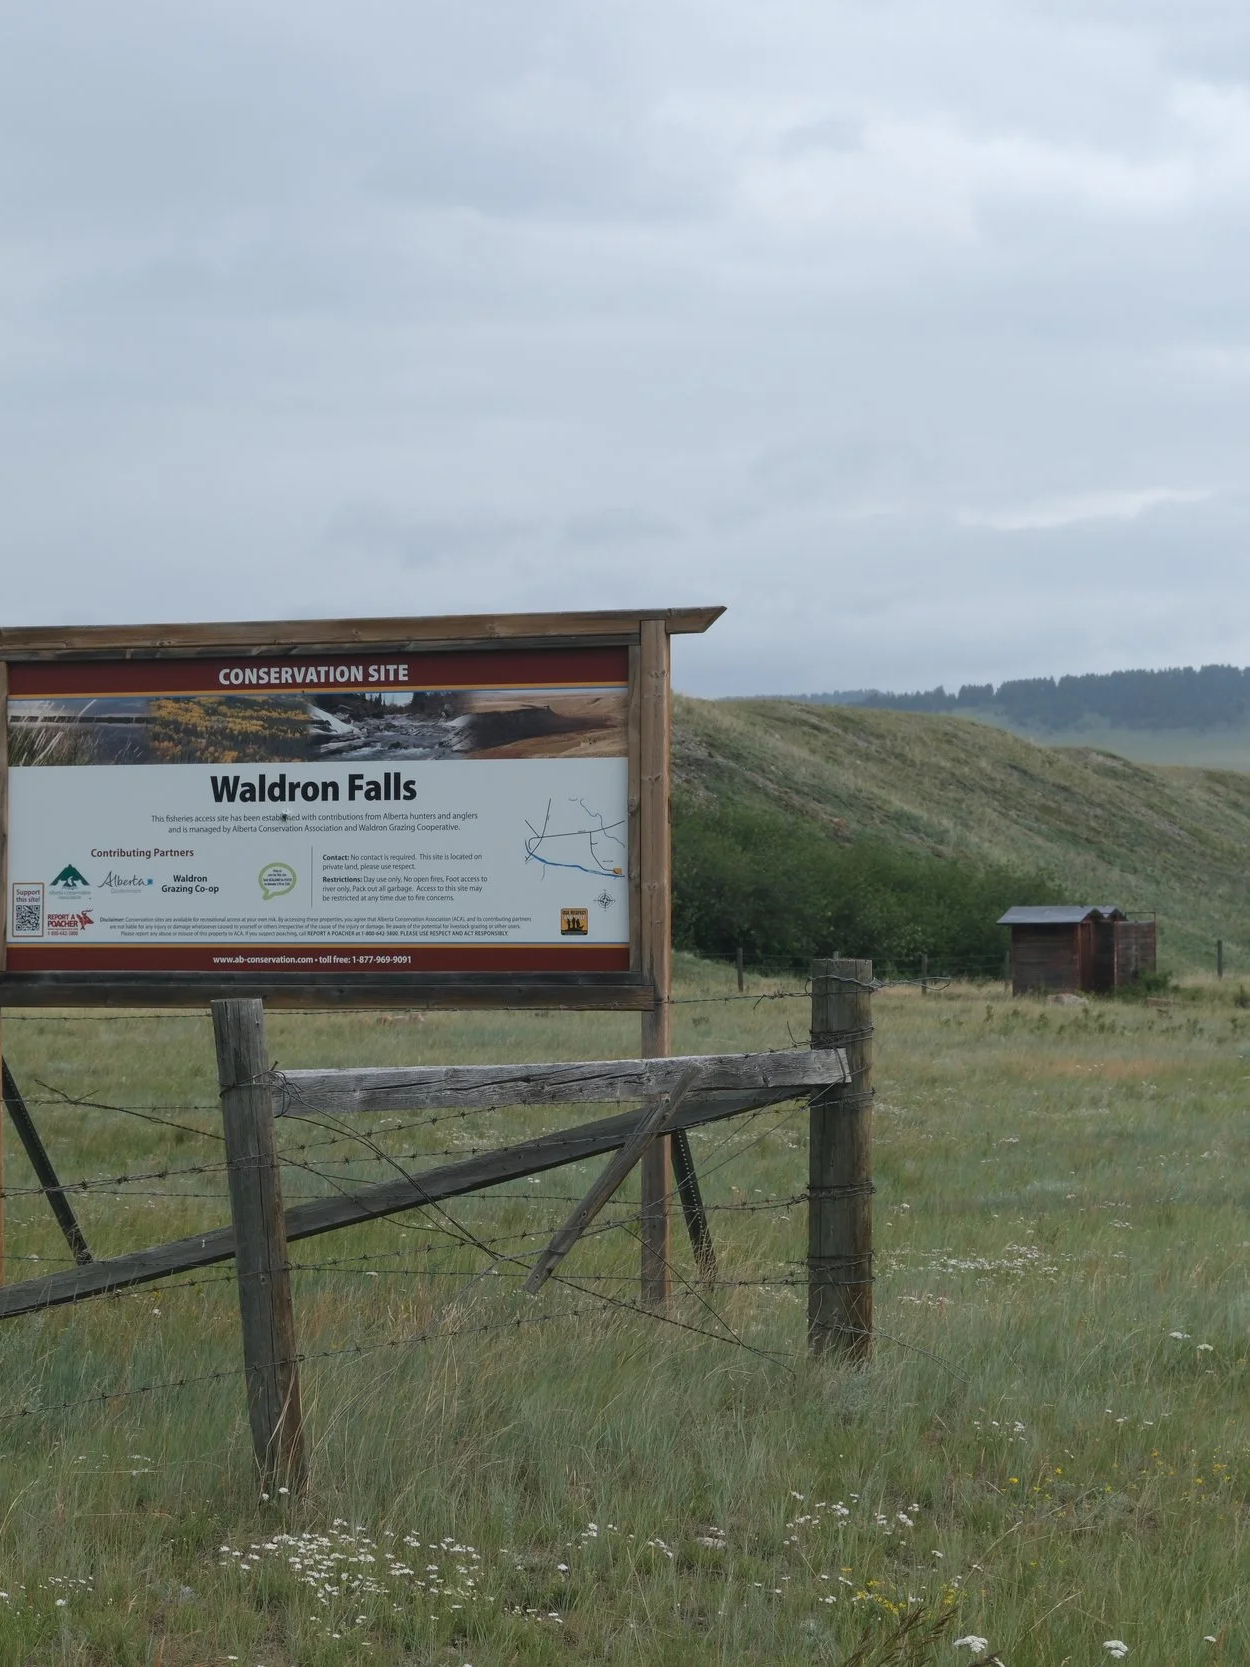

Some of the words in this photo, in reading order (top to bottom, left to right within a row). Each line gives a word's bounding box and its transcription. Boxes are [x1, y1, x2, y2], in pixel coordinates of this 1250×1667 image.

[218, 666, 363, 684] CONSERVATION
[369, 664, 409, 681] SITE
[210, 773, 339, 802] Waldron
[348, 772, 417, 801] Falls
[452, 812, 478, 821] anglers
[189, 825, 221, 834] managed
[222, 825, 231, 834] by
[389, 823, 416, 832] Grazing
[416, 823, 460, 832] Cooperative.
[91, 848, 151, 860] Contributing
[154, 848, 194, 857] Partners
[390, 854, 417, 862] required.
[322, 863, 343, 871] private
[344, 863, 359, 871] land,
[360, 863, 380, 871] please
[392, 863, 416, 871] respect.
[98, 870, 147, 888] Alberta
[363, 876, 375, 884] Day
[388, 876, 402, 884] only,
[430, 876, 444, 884] fires,
[16, 889, 40, 897] Support
[161, 884, 193, 894] Grazing
[195, 884, 219, 894] Co-op
[336, 885, 351, 893] only,
[387, 885, 414, 893] garbage.
